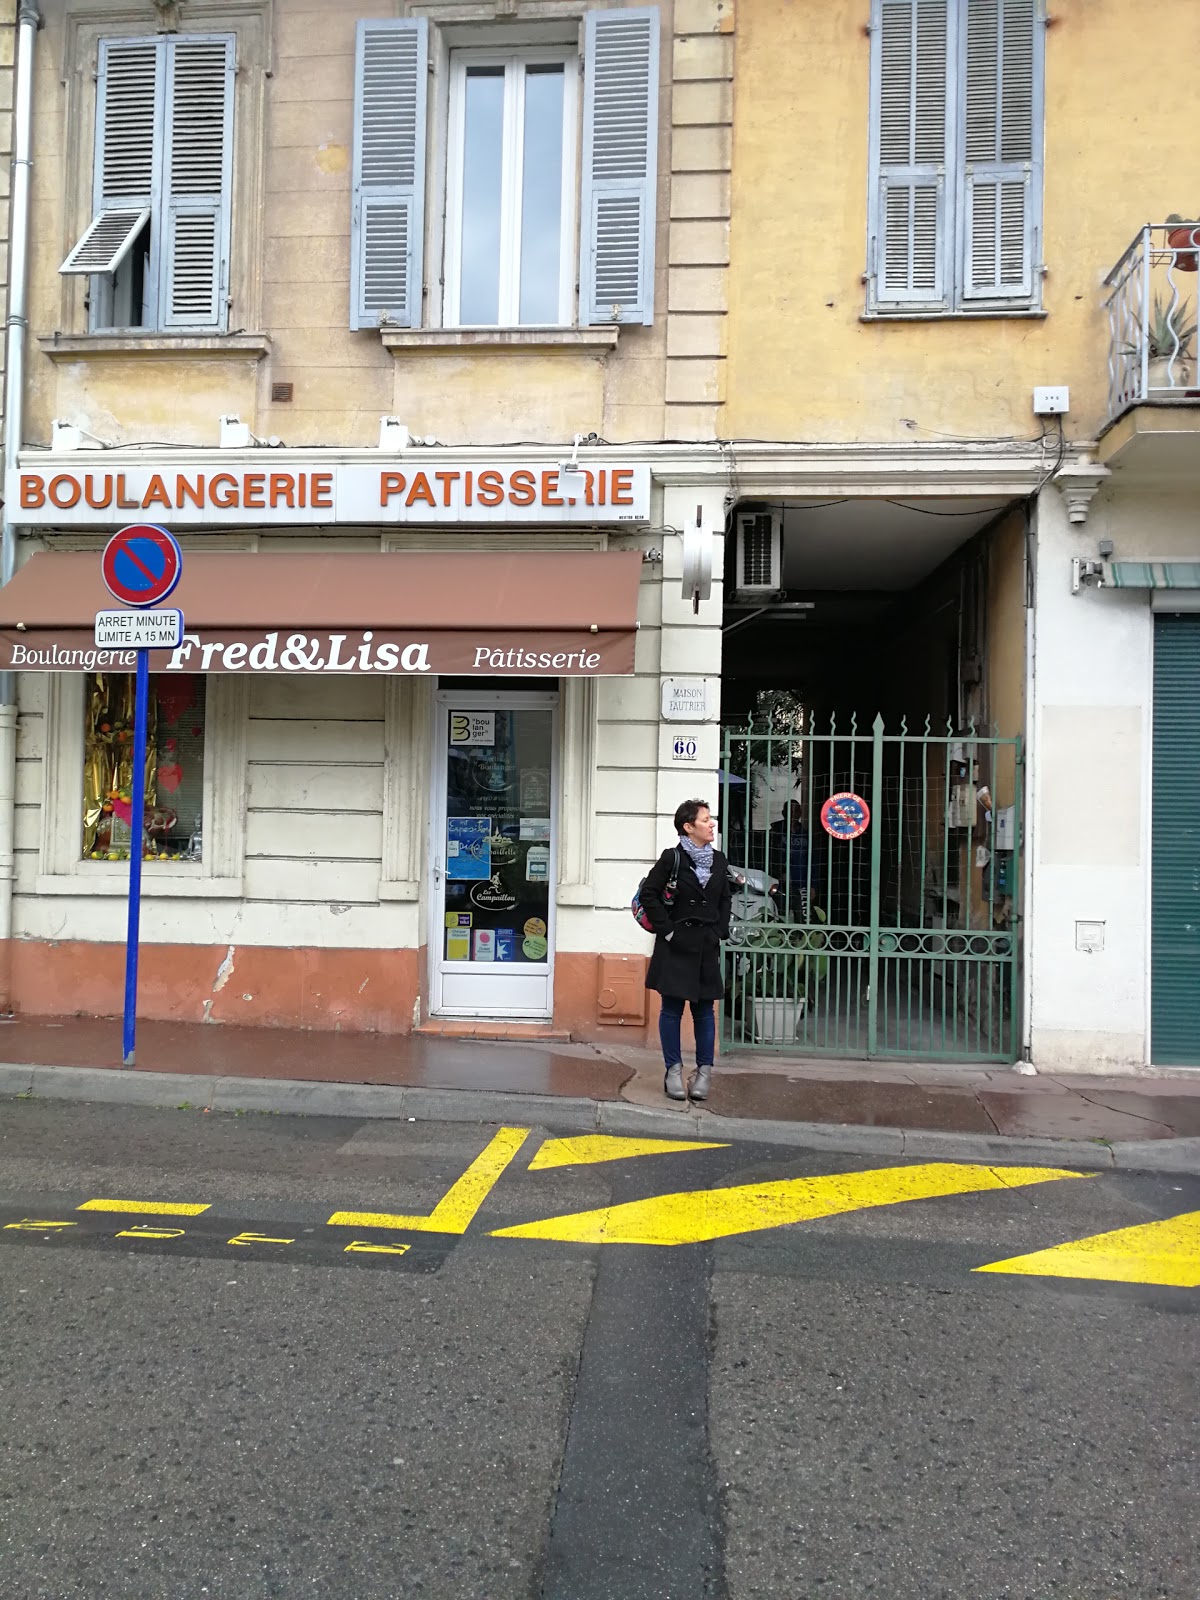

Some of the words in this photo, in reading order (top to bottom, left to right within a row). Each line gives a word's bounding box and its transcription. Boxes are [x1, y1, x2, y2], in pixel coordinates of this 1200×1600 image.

[20, 472, 333, 509] BOULANGERIE
[380, 469, 634, 507] PATISSERIE
[98, 616, 133, 627] ARRET
[136, 615, 176, 627] MINUTE
[98, 631, 131, 642] LIMITE
[134, 631, 141, 642] A
[145, 631, 156, 642] 15
[159, 630, 175, 641] MN
[10, 644, 136, 671] Boulangerie
[166, 631, 431, 671] Fred&Lisa
[472, 647, 601, 668] Pâtisserie
[673, 689, 702, 697] MAISON
[674, 741, 696, 755] 60
